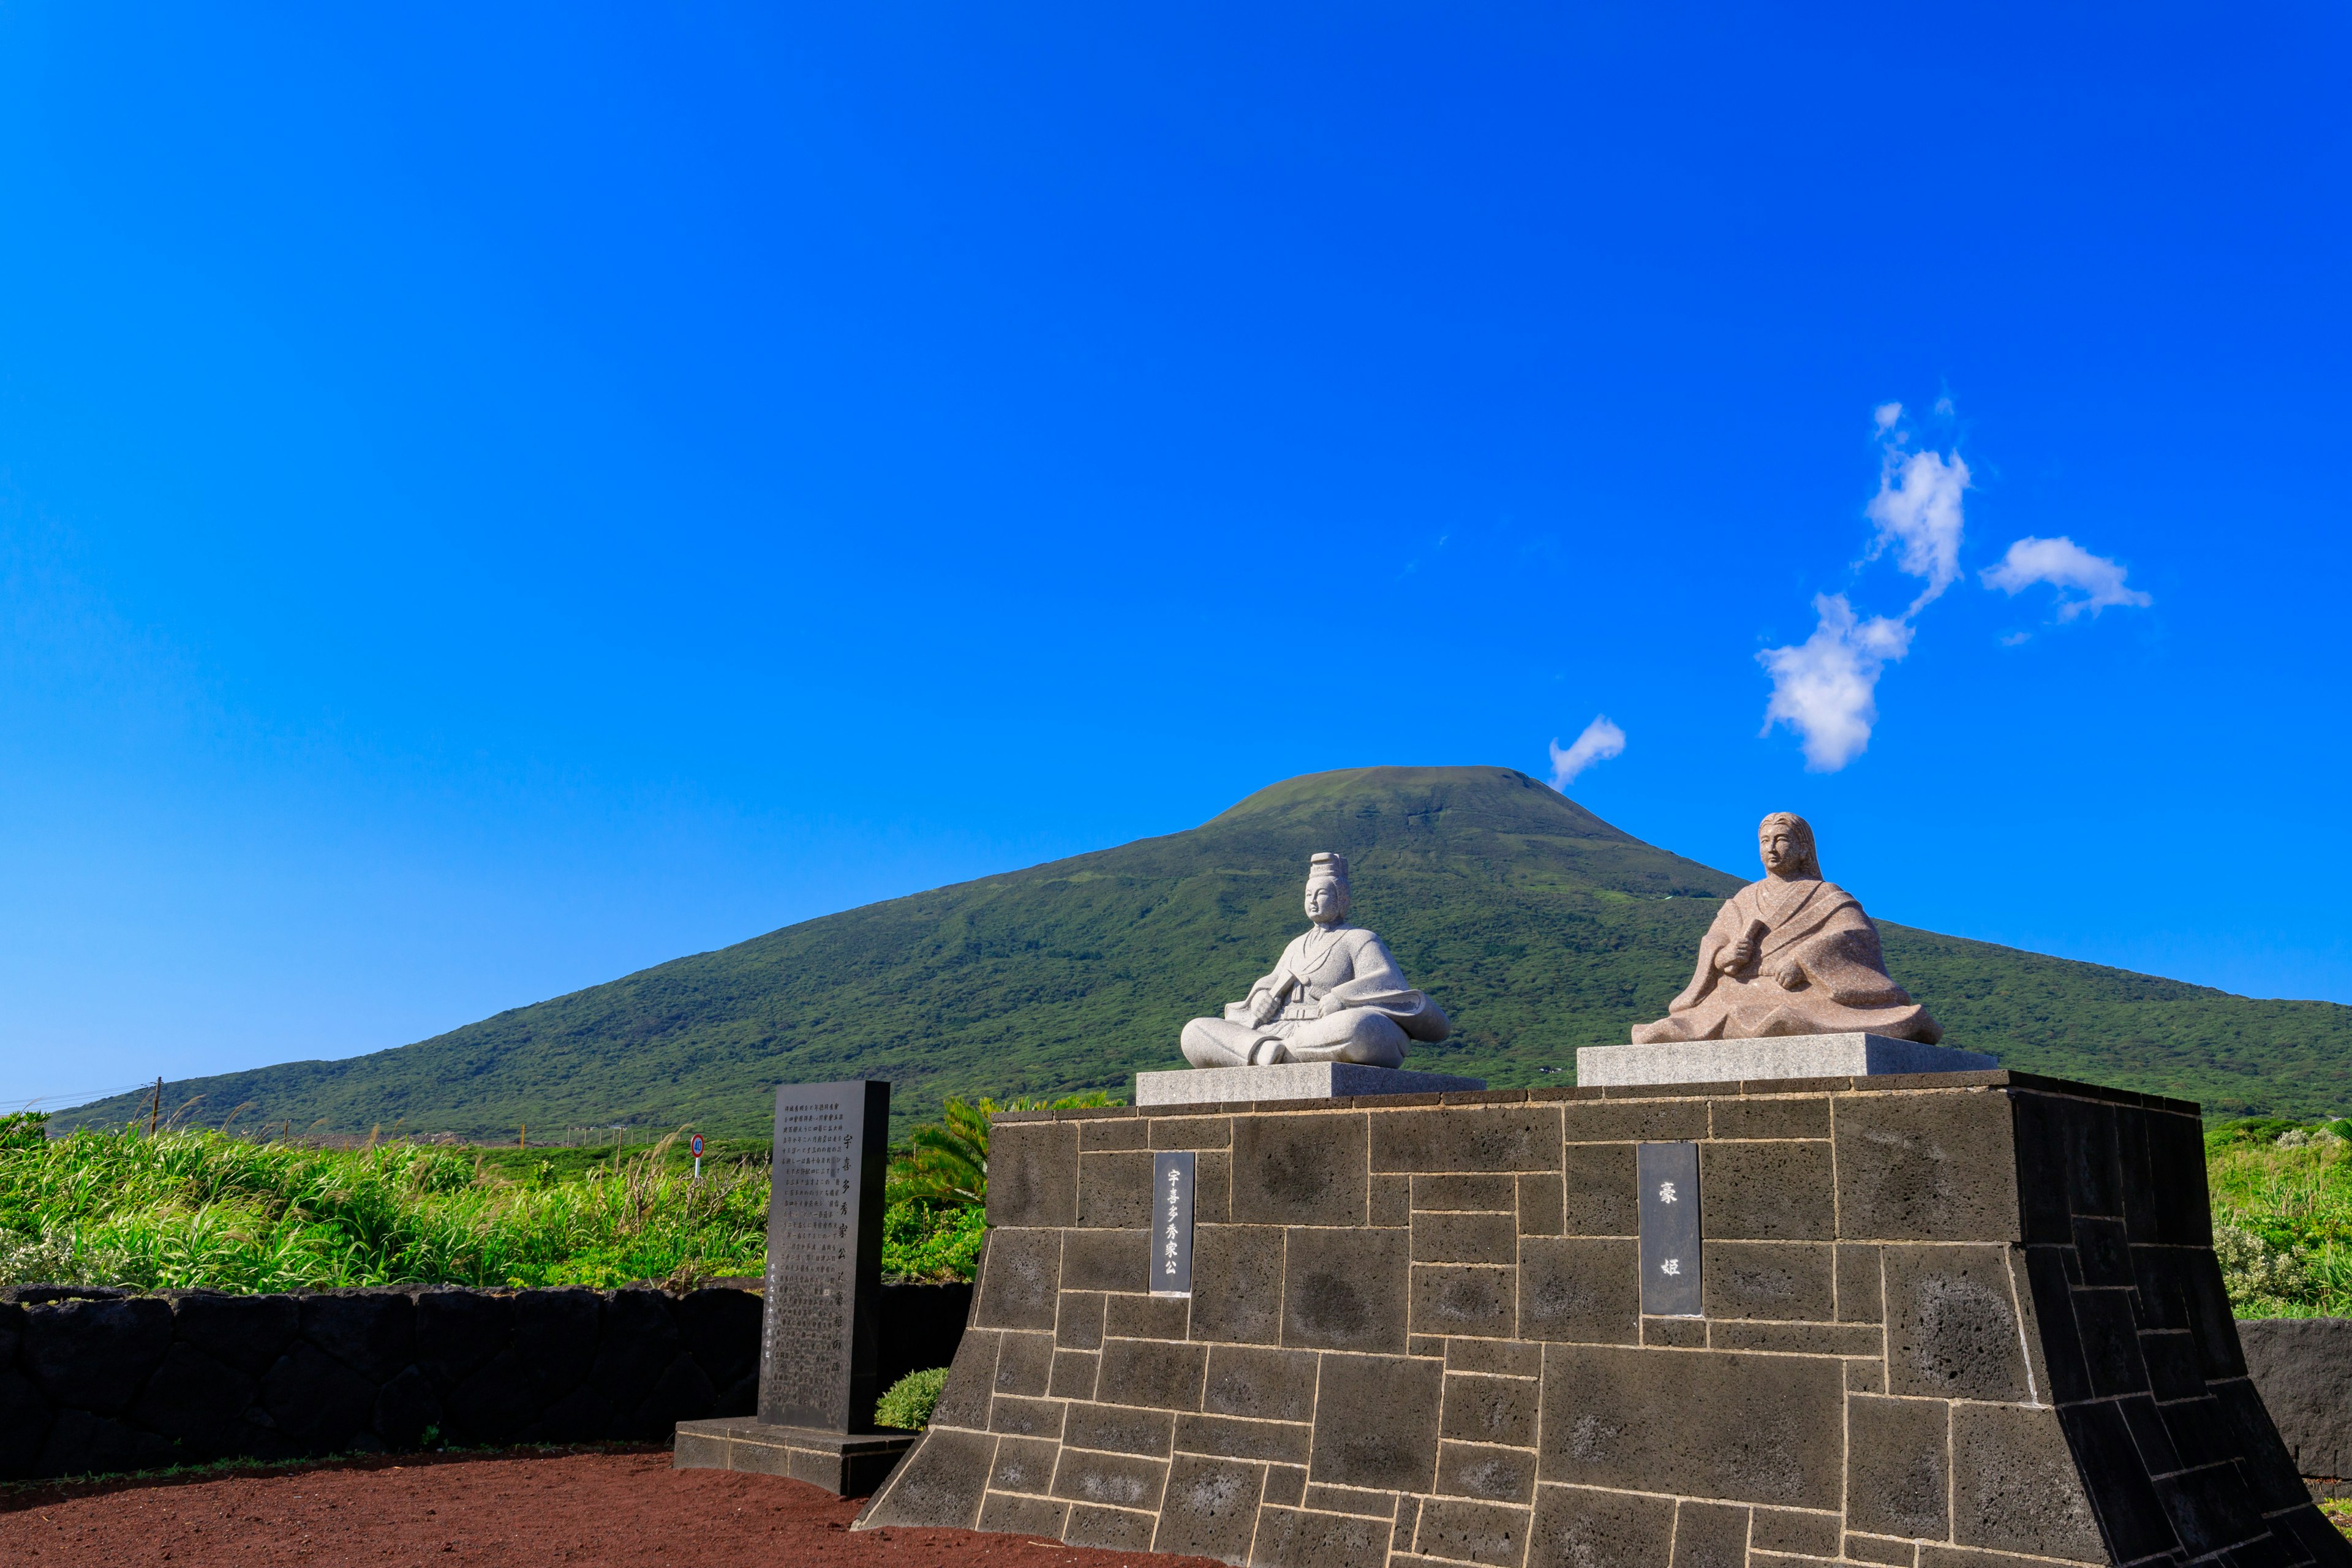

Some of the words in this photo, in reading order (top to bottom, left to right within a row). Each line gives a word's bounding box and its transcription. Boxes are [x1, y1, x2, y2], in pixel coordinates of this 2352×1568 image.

[694, 1140, 701, 1151] 40
[1165, 1169, 1181, 1275] 宇喜多秀家公
[1659, 1182, 1680, 1276] 豪姫
